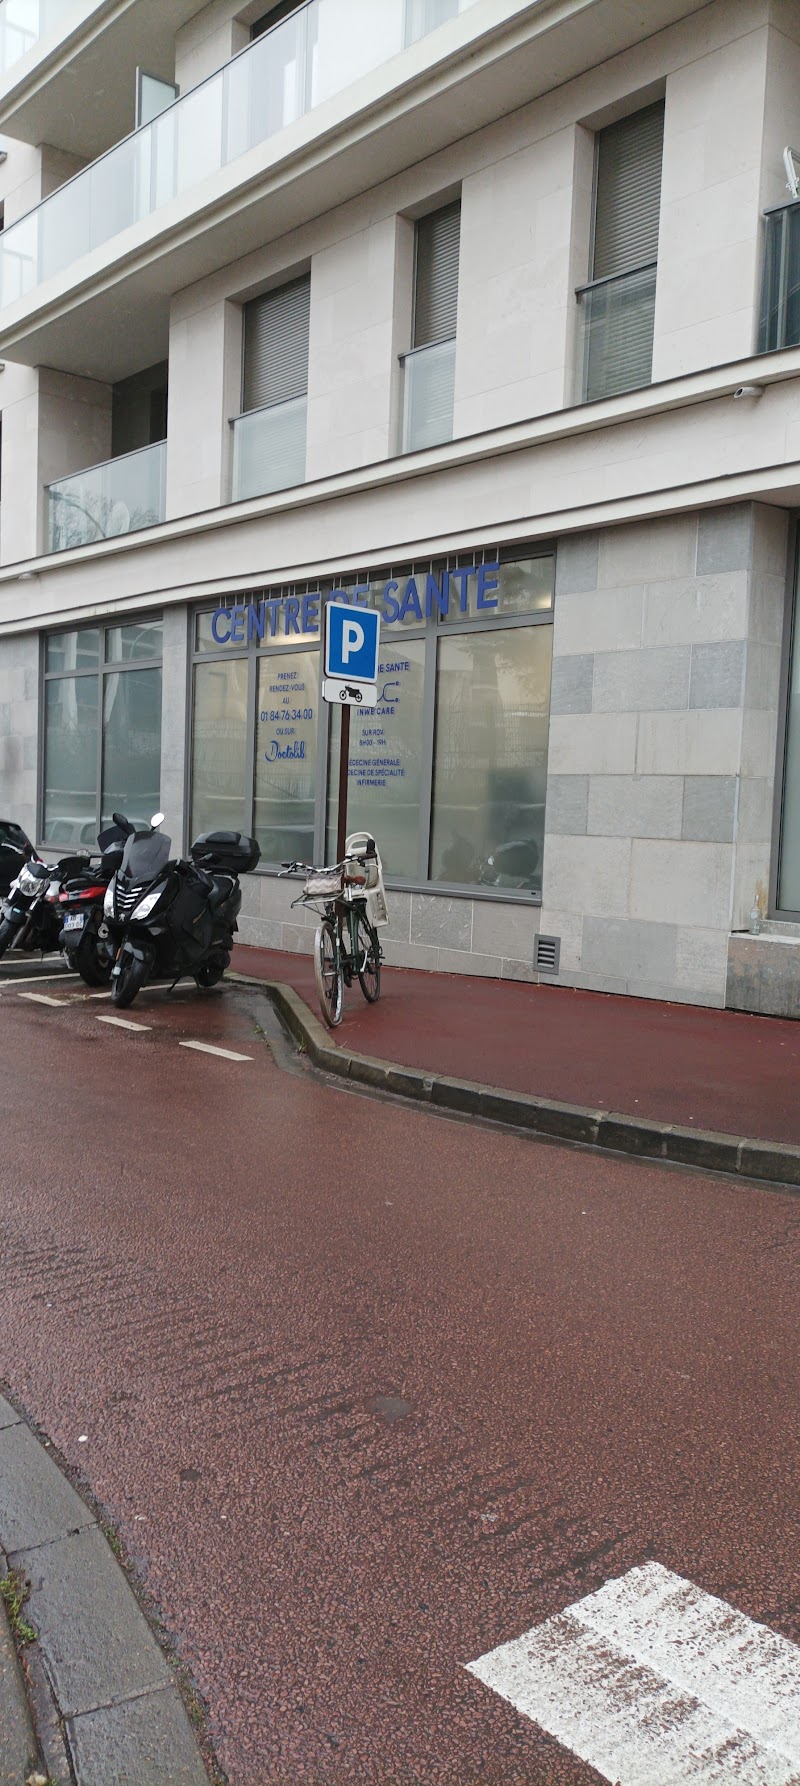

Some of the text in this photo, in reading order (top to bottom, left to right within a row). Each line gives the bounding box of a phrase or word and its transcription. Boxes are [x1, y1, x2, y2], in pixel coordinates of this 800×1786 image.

[211, 593, 320, 643] CENTRE
[382, 563, 500, 624] SANTE
[341, 619, 365, 664] P
[278, 672, 297, 680] PRENEZ
[269, 683, 305, 692] RENDEZ-VOUS
[261, 708, 313, 721] 01 84 76 34 00
[376, 706, 395, 715] CARE
[284, 727, 295, 735] SUR
[265, 740, 305, 762] Doctolib
[357, 778, 386, 787] INFIRMERIE
